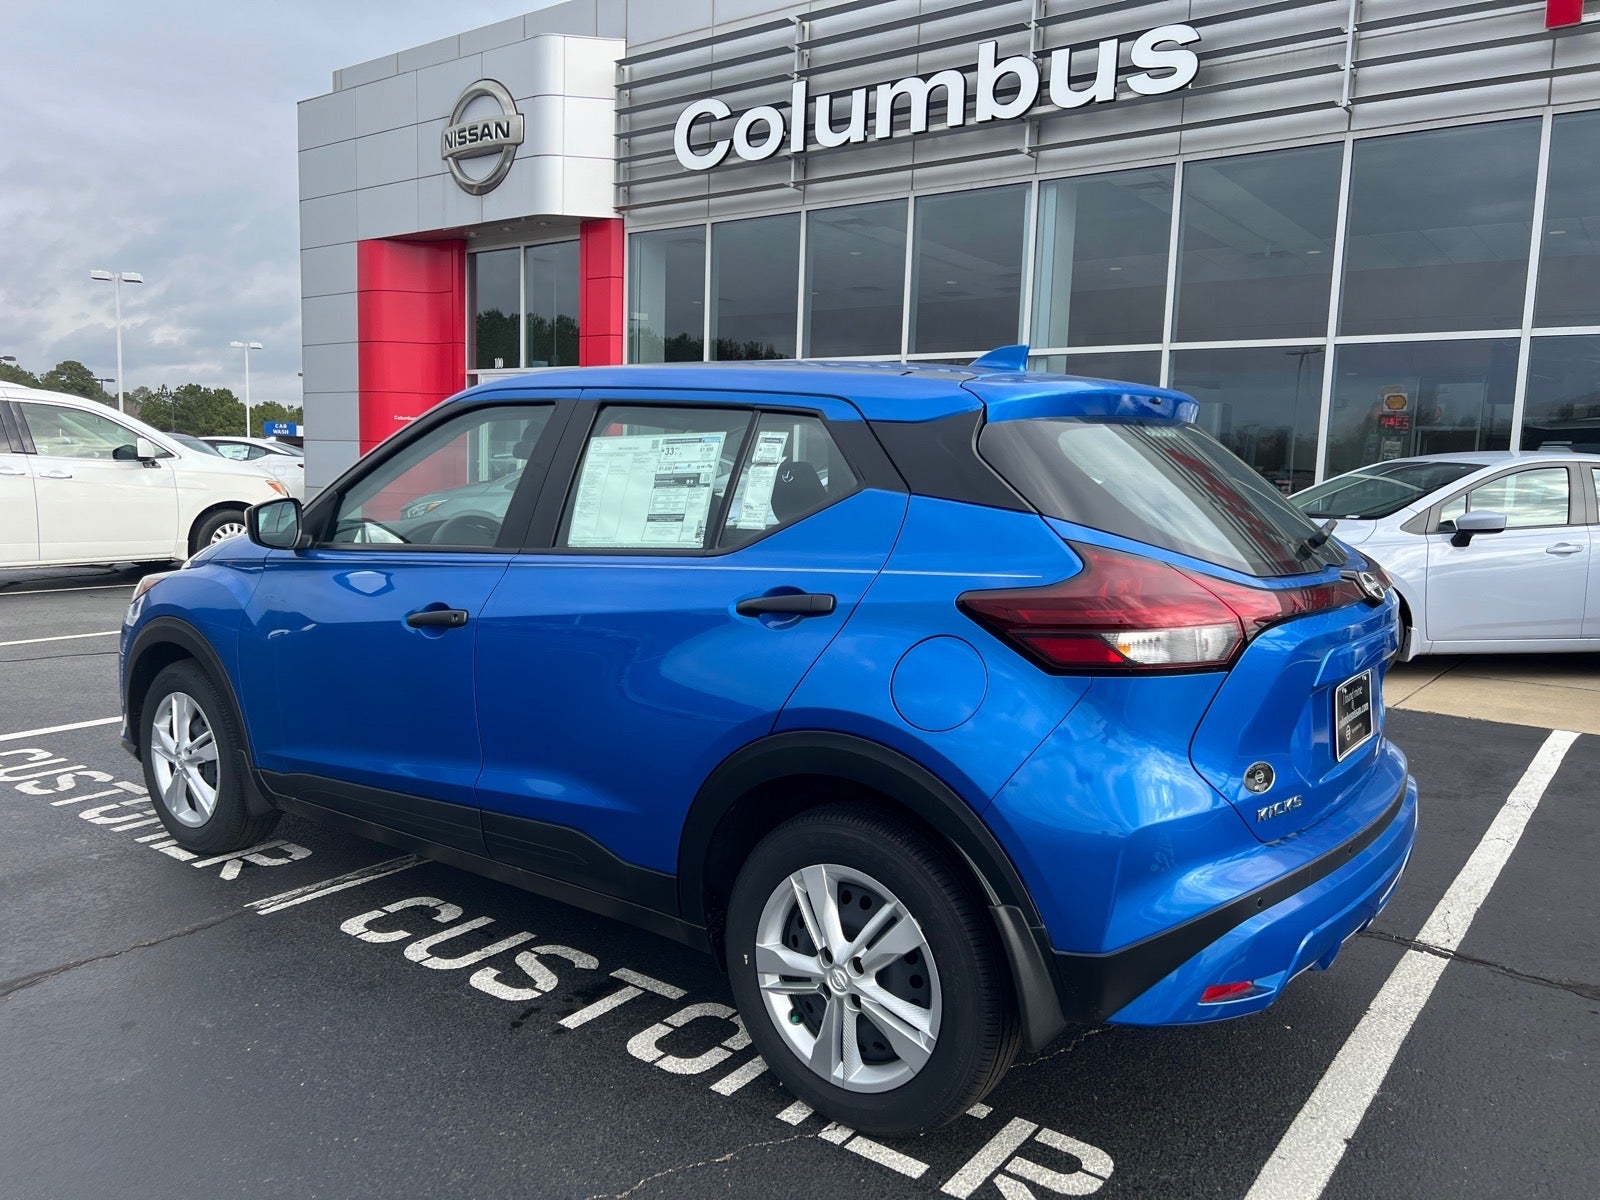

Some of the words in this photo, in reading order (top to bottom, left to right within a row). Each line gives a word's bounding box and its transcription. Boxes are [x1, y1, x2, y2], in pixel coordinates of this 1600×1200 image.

[443, 121, 510, 151] NISSAN
[673, 23, 1201, 170] Columbus
[1256, 795, 1303, 823] KICKS
[339, 896, 1114, 1200] CUSTOR
